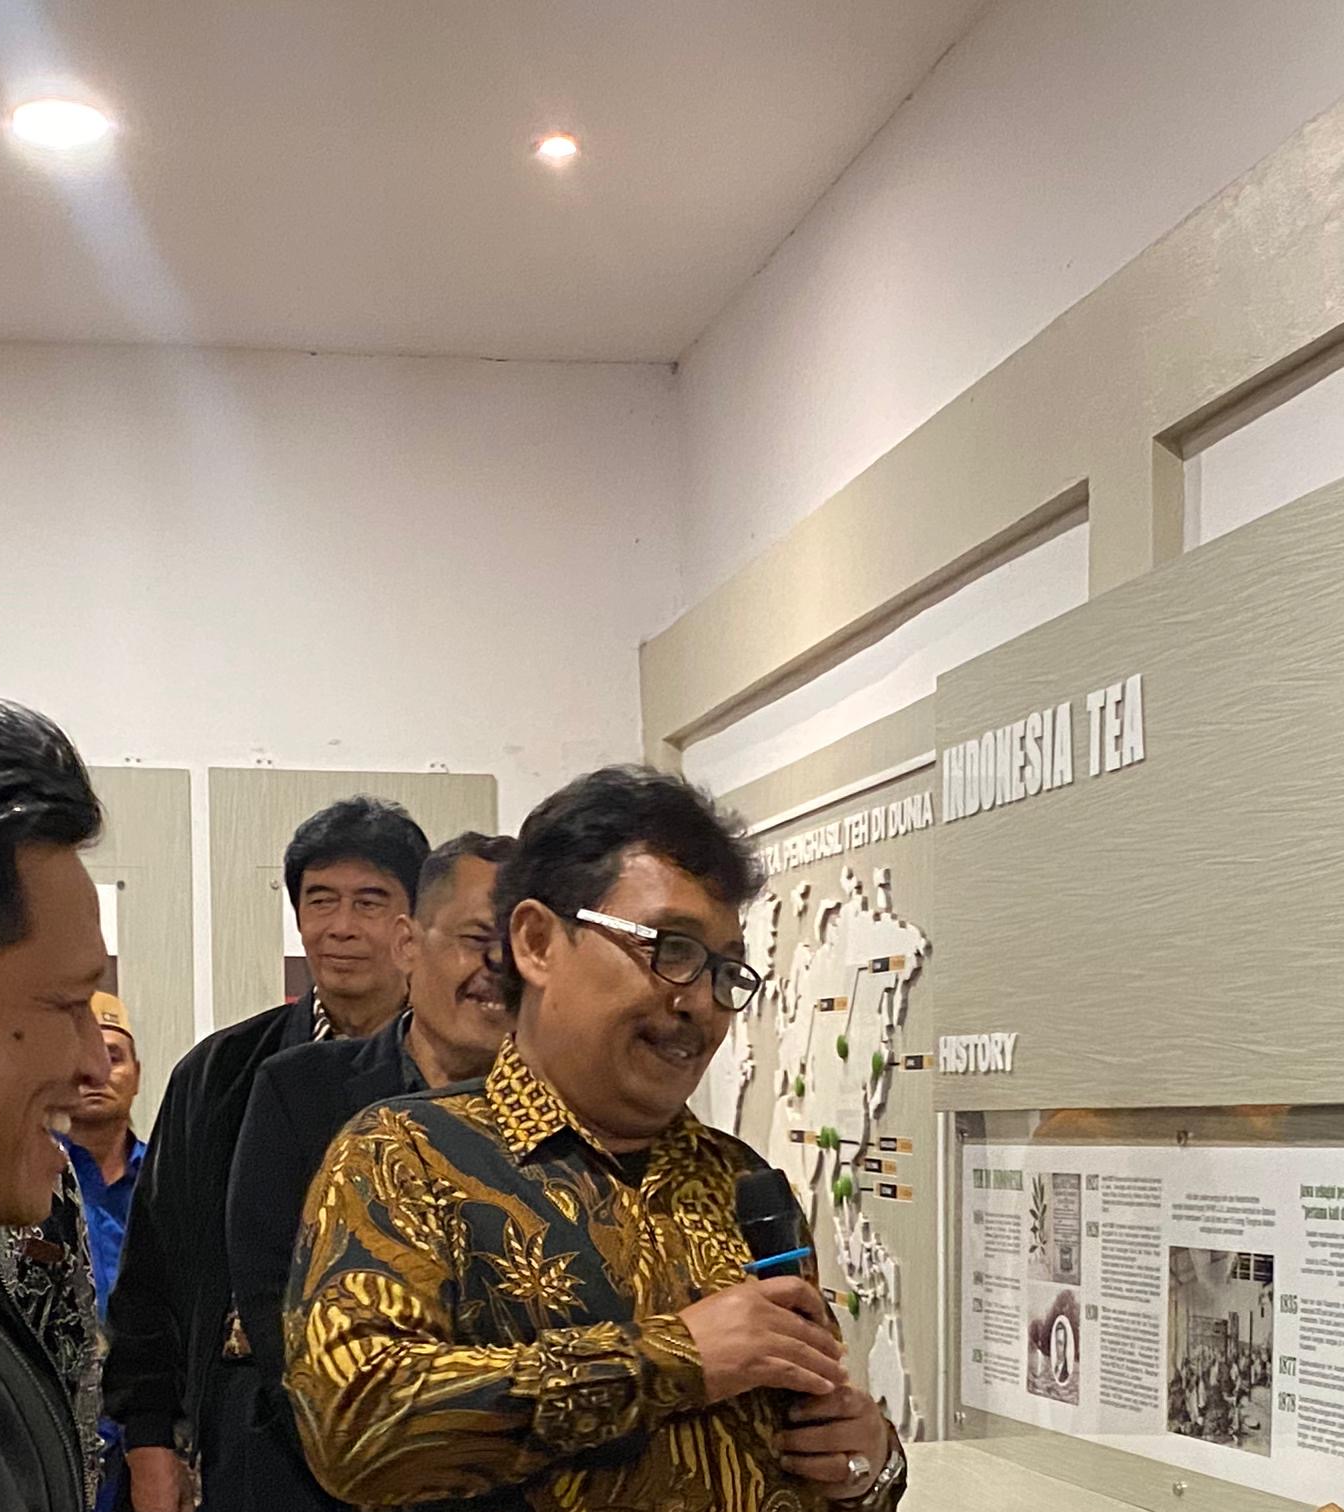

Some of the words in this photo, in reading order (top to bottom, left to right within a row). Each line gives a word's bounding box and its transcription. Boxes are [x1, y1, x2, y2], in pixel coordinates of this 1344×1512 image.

[942, 702, 1073, 823] INDONESIA
[1086, 673, 1144, 777] TEA
[783, 821, 844, 870] PENGHASIL
[844, 811, 870, 849] TEH
[871, 806, 886, 842] DI
[888, 792, 934, 838] DUNIA
[939, 1032, 1019, 1073] HISTORY
